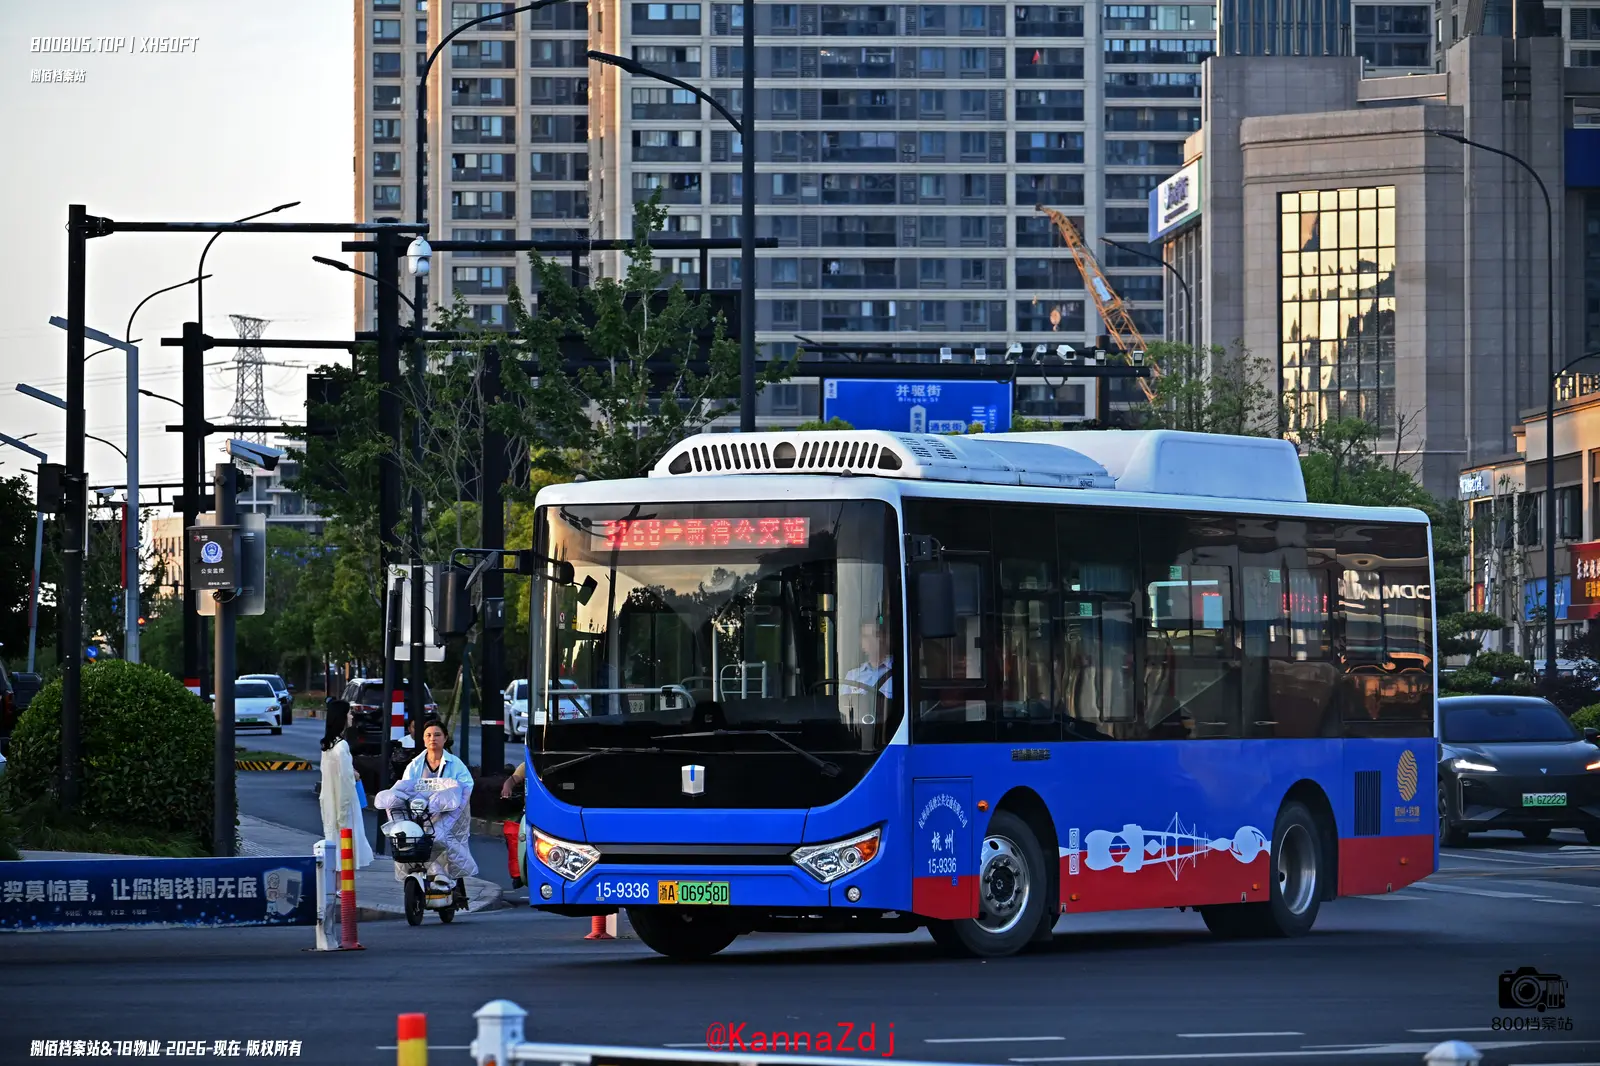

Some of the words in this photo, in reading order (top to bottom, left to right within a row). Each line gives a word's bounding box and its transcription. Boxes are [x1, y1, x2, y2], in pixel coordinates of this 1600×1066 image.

[896, 384, 942, 397] 并驱街
[931, 829, 955, 855] 杭州
[928, 858, 957, 874] 15-9336
[0, 879, 97, 903] 奖莫惊喜，
[111, 876, 259, 901] 让您掏钱洞无底
[596, 882, 650, 899] 15-9336
